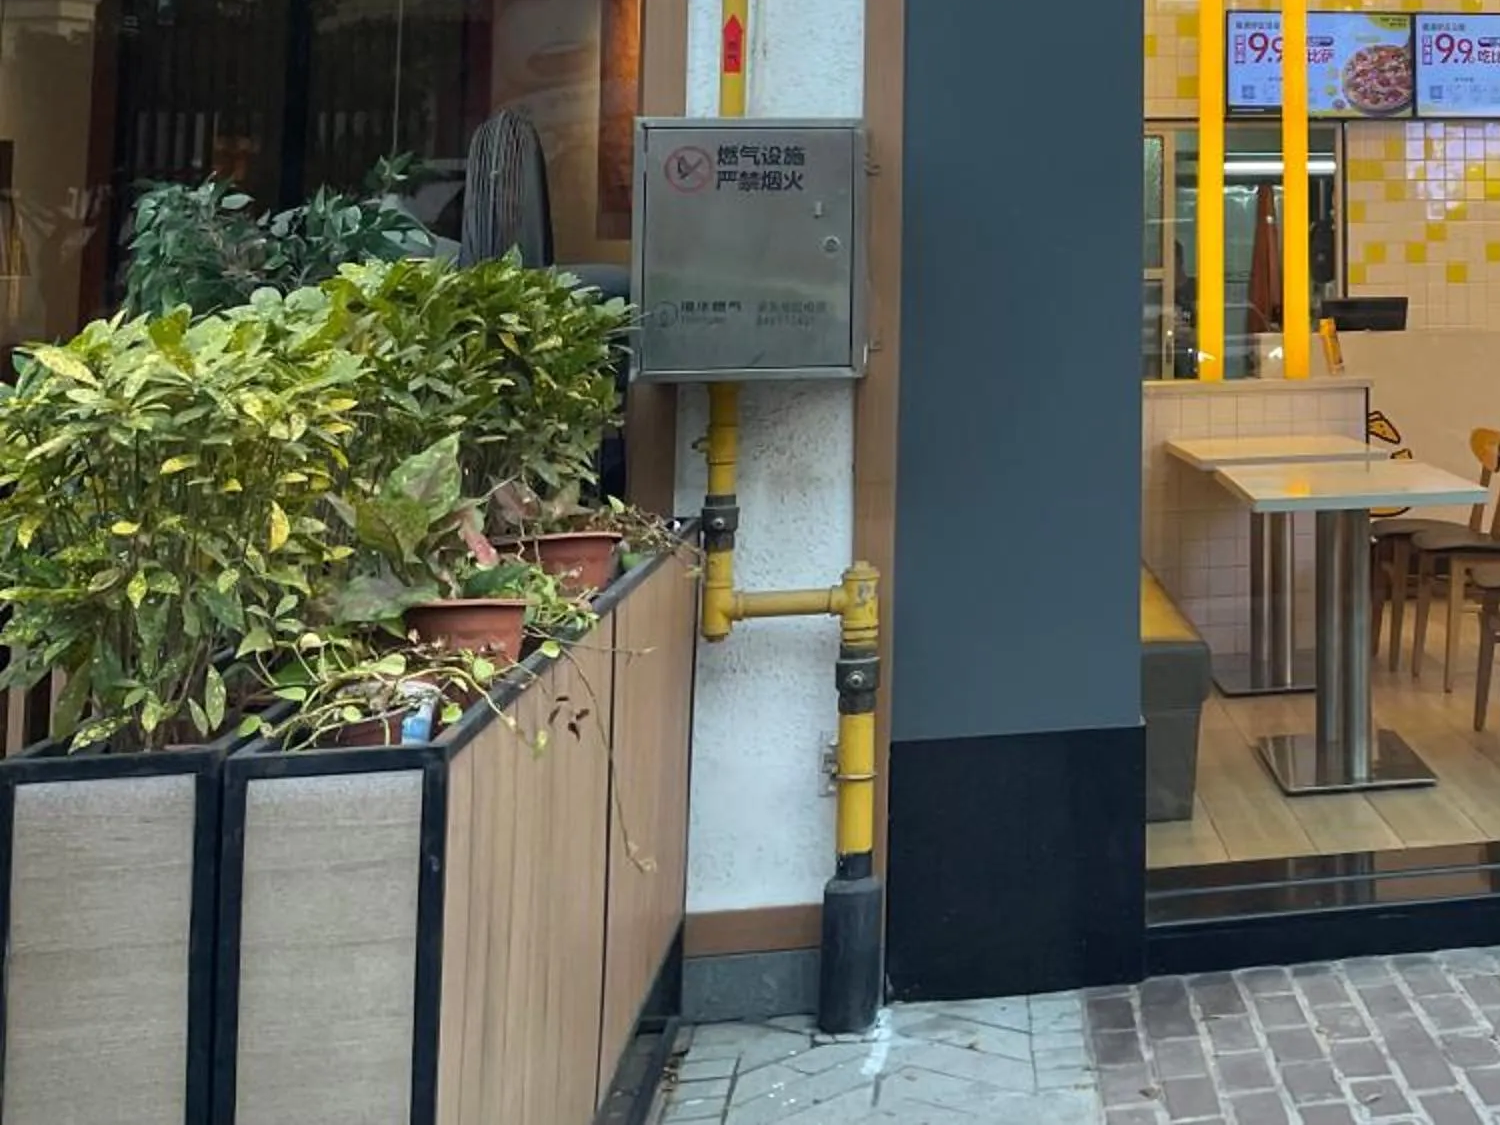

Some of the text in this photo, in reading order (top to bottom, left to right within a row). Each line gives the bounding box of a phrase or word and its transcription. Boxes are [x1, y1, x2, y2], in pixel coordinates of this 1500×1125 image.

[717, 145, 806, 166] 燃气设施
[716, 171, 804, 191] 严禁烟火
